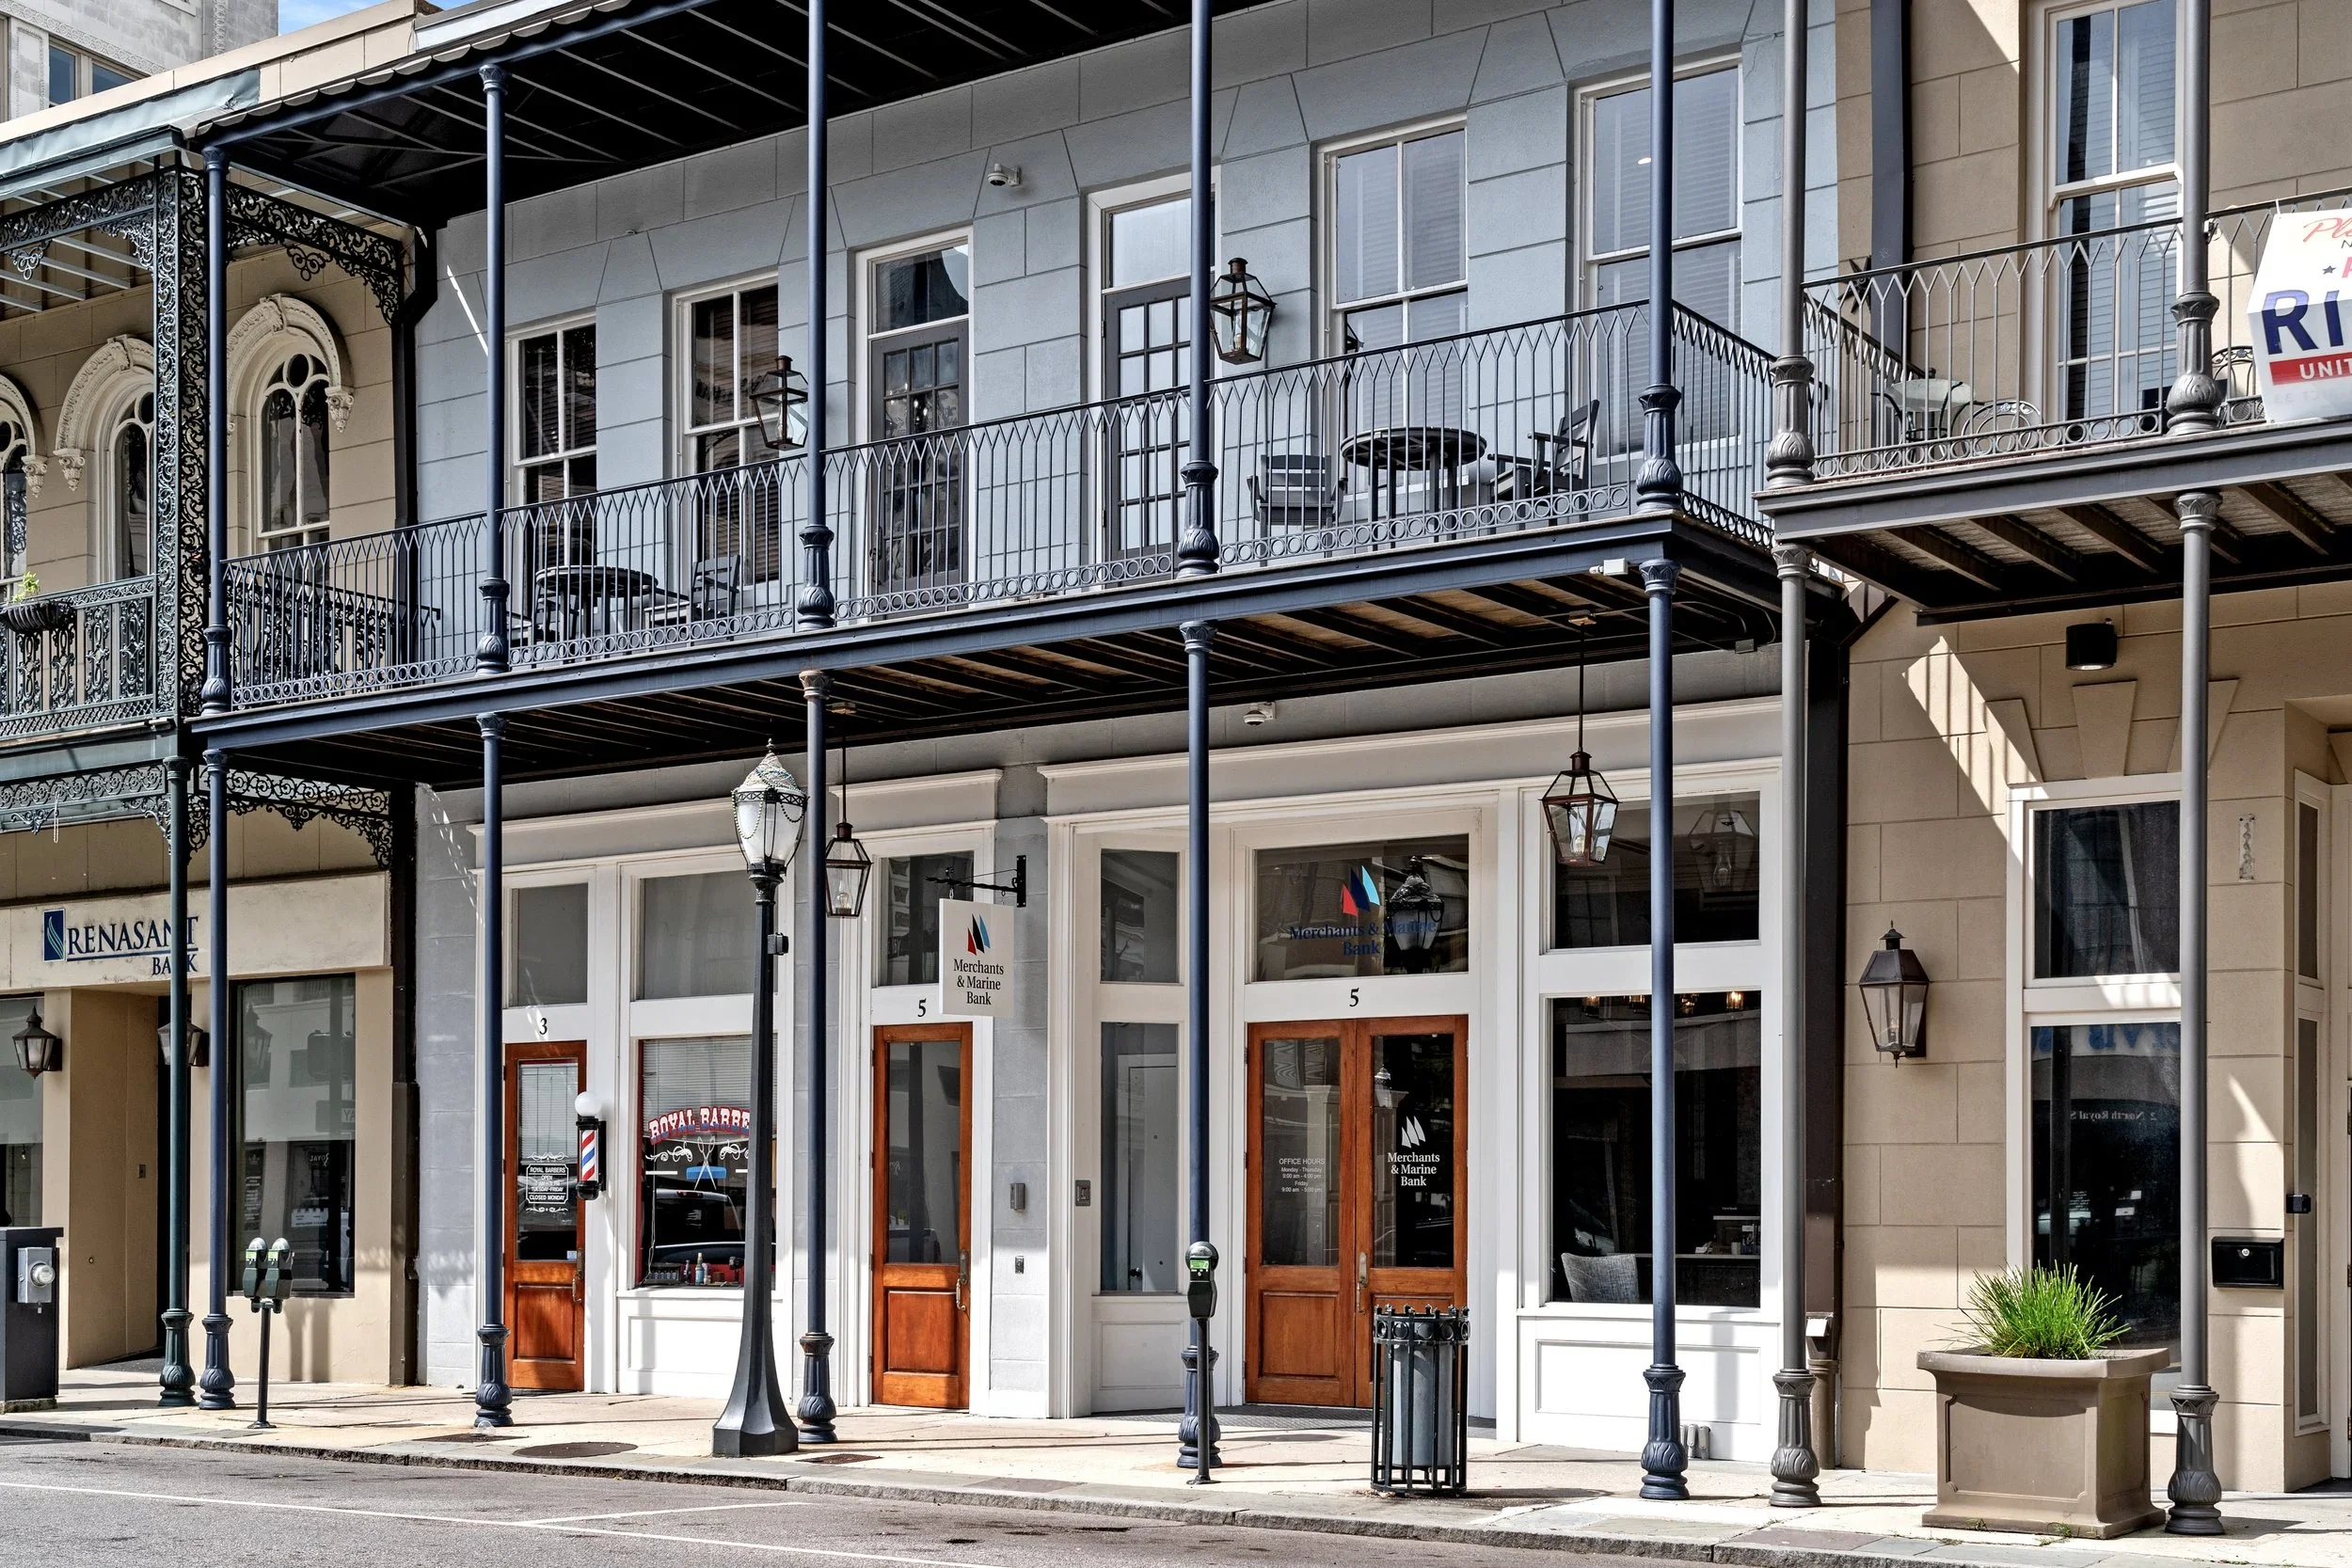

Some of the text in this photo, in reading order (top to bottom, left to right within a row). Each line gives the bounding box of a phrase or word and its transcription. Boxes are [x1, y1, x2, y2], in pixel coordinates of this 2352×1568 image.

[1290, 924, 1364, 940] Merchants
[1369, 922, 1378, 936] &
[1343, 940, 1379, 956] Bank
[151, 953, 199, 976] BAK
[953, 958, 1005, 975] Merchants
[957, 974, 1001, 990] & Marine
[966, 991, 992, 1006] Bank
[1349, 988, 1359, 1007] 5
[917, 998, 927, 1018] 5
[539, 1017, 548, 1035] 3
[648, 1105, 750, 1145] ROYAL BARBE
[1387, 1151, 1440, 1163] Merchants
[1391, 1164, 1438, 1175] & Marine
[1401, 1175, 1427, 1186] Bank
